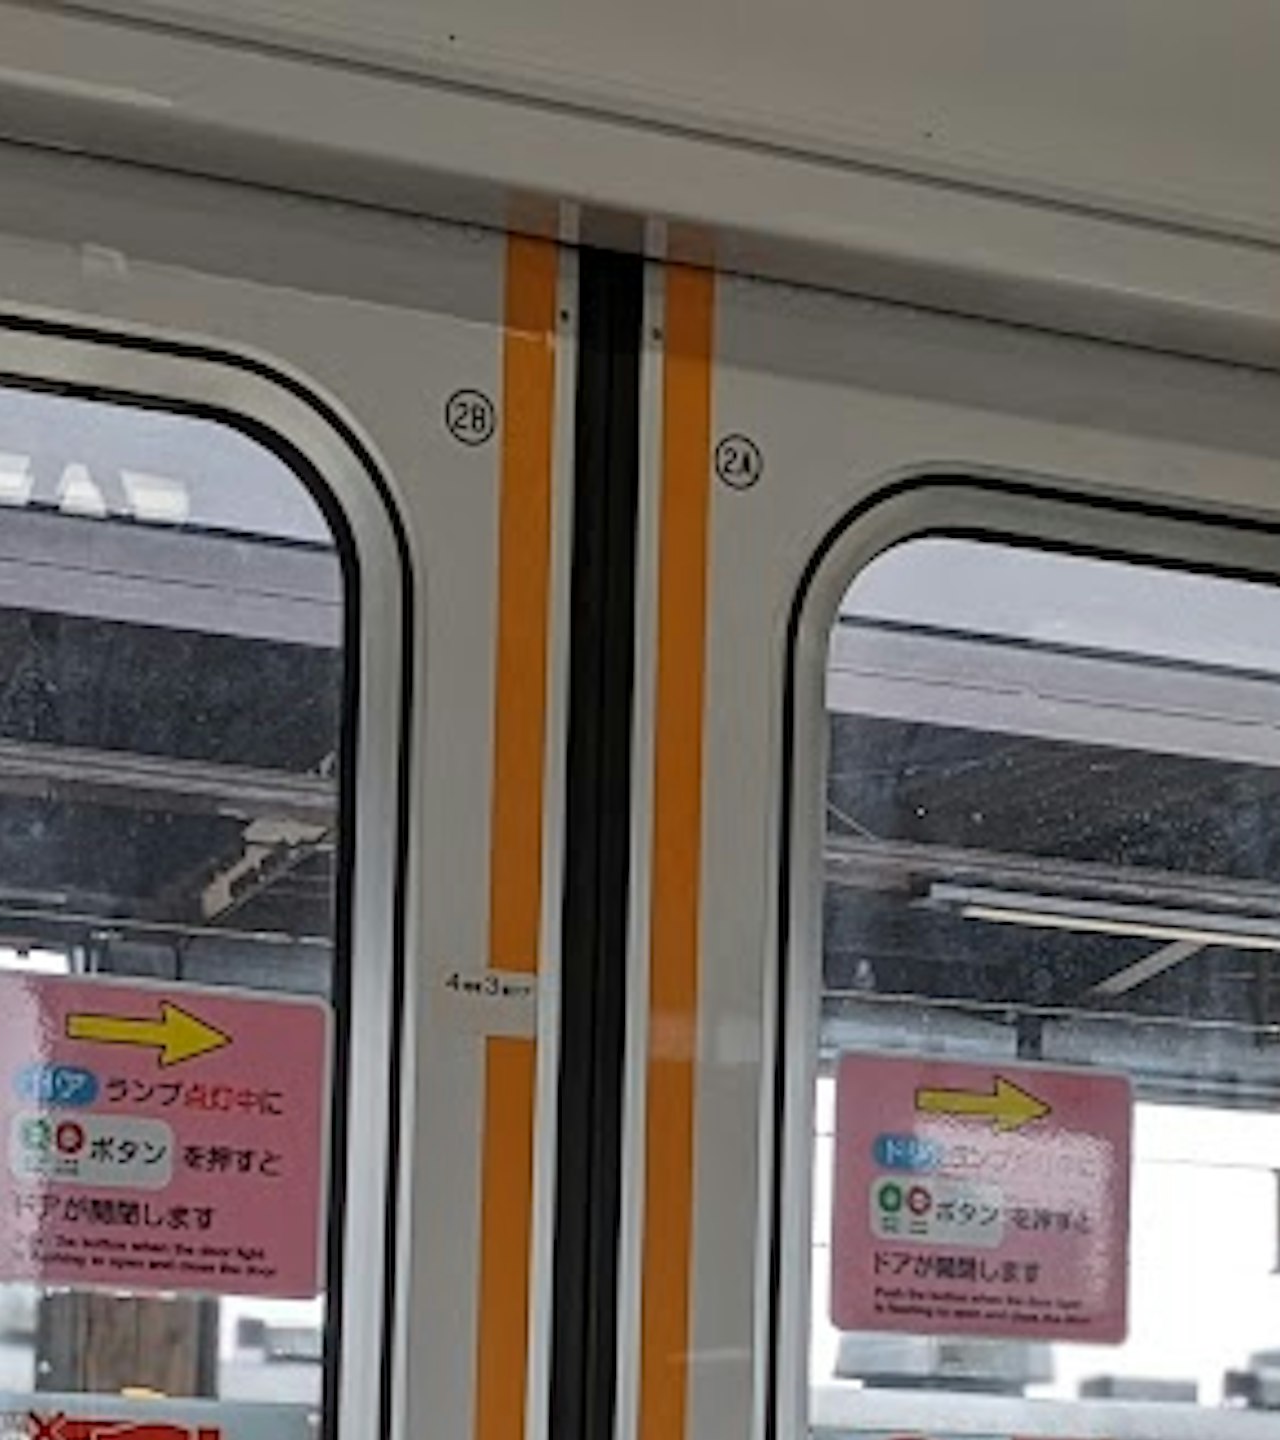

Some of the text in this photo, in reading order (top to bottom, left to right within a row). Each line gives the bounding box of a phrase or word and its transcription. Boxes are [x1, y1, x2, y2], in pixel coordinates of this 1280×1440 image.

[90, 1136, 168, 1165] ボタン
[872, 1250, 1042, 1285] ドアが開閉します
